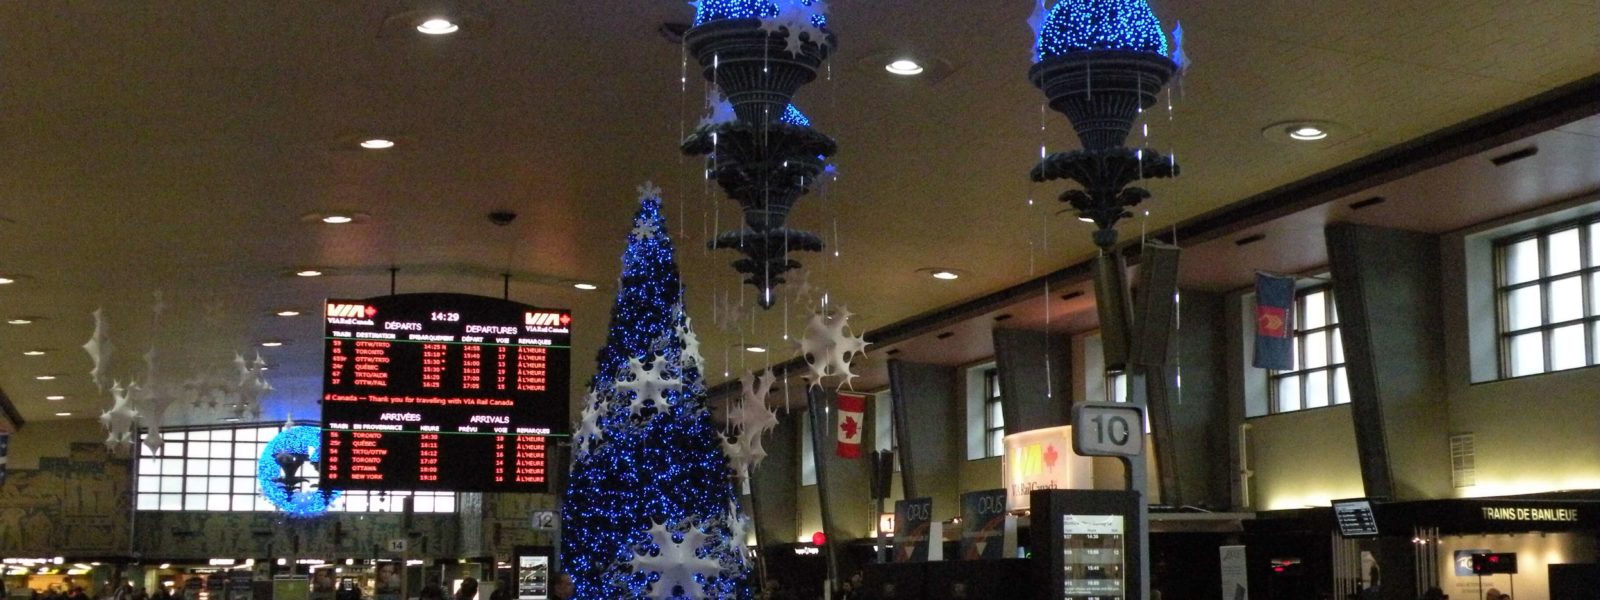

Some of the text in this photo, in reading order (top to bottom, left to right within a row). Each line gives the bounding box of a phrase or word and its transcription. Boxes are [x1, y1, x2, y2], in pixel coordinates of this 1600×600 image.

[328, 304, 364, 317] VIA
[431, 312, 459, 321] 14:29
[384, 320, 422, 330] DÉPARTS
[525, 312, 560, 325] VIA
[465, 325, 517, 335] DEPARTURES
[380, 412, 421, 421] ARRIVÉES
[470, 415, 510, 424] ARRIVALS
[1091, 414, 1129, 446] 10
[979, 496, 1004, 514] OPUS
[907, 504, 930, 520] OPUS
[1482, 508, 1578, 521] TRAINS DE BANLIEUE
[534, 513, 553, 528] 12
[391, 541, 402, 549] 14
